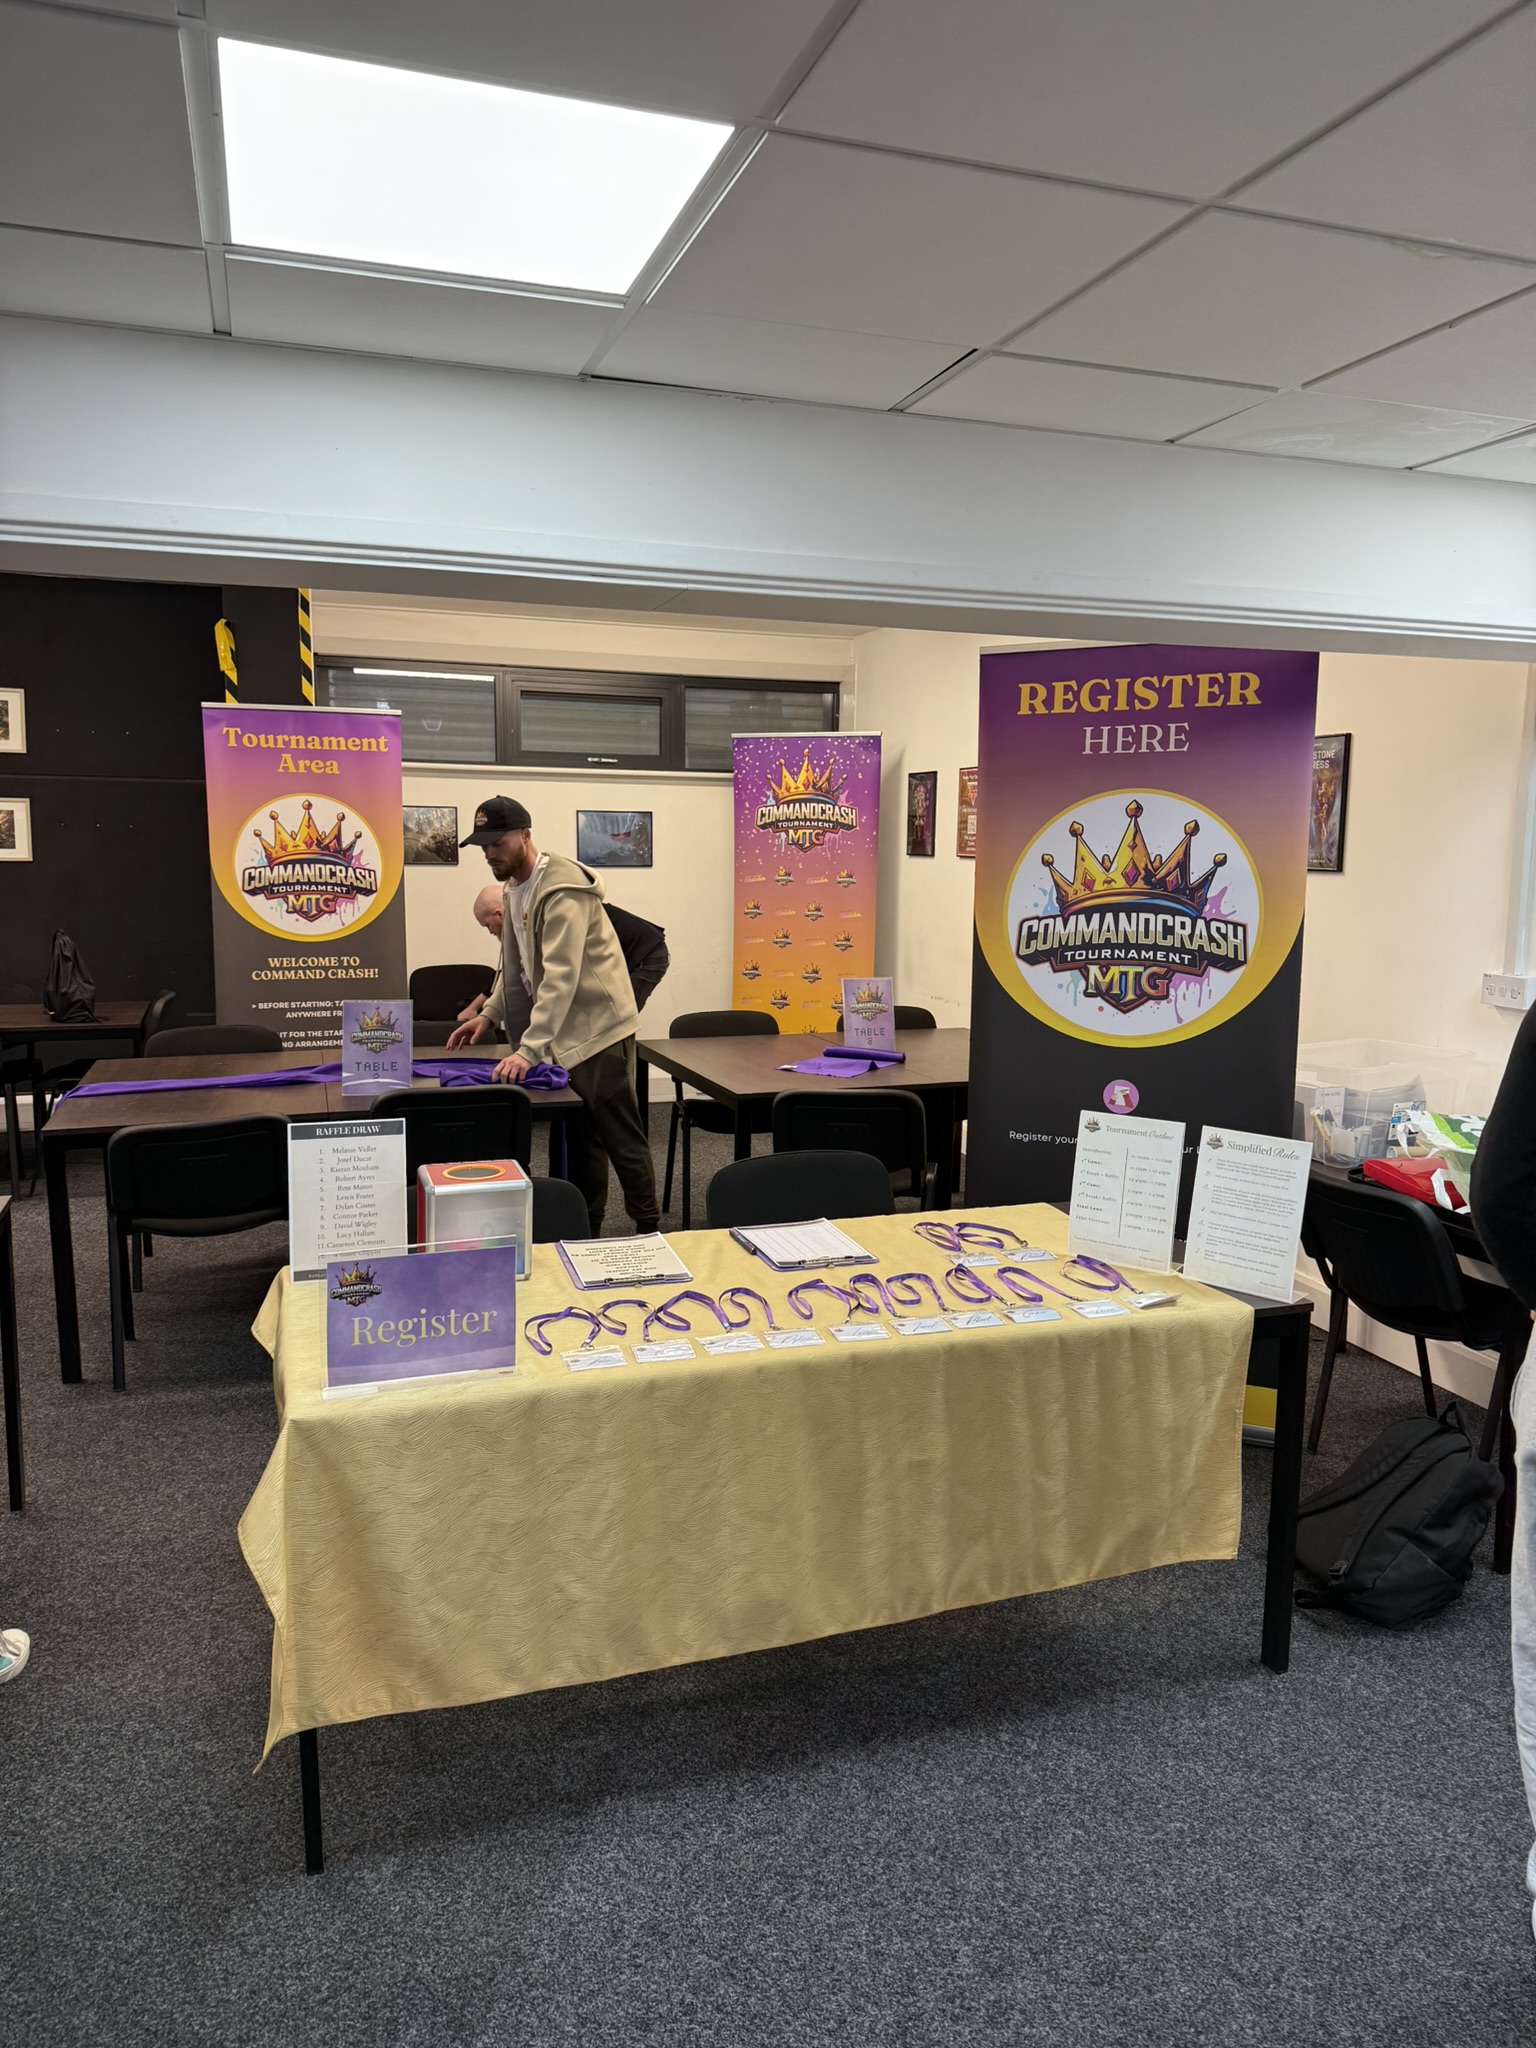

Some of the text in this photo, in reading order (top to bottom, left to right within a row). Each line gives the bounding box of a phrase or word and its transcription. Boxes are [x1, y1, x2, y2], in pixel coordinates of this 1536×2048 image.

[1017, 672, 1262, 716] REGISTER
[222, 726, 389, 752] Tournament
[1081, 722, 1190, 756] HERE
[277, 753, 340, 775] Area
[757, 804, 857, 826] COMMANDCRASH
[788, 829, 824, 848] MTG
[243, 863, 378, 891] COMMANDCRASH
[272, 885, 348, 894] TOURNAMENT
[287, 894, 336, 916] MTG
[1018, 912, 1246, 962] COMMANDCRASH
[268, 956, 360, 968] WELCOME TO
[1064, 948, 1192, 964] TOURNAMENT
[252, 968, 379, 981] COMMAND CRASH!
[1086, 964, 1169, 1001] MTG
[854, 1028, 886, 1036] TABLE
[355, 1062, 398, 1072] TABLE
[316, 1125, 381, 1136] RAFFLE DRAW
[1009, 1131, 1052, 1144] Register
[1106, 1125, 1174, 1141] Tournament Outline
[1227, 1140, 1272, 1156] Simplified
[351, 1308, 498, 1348] Register
